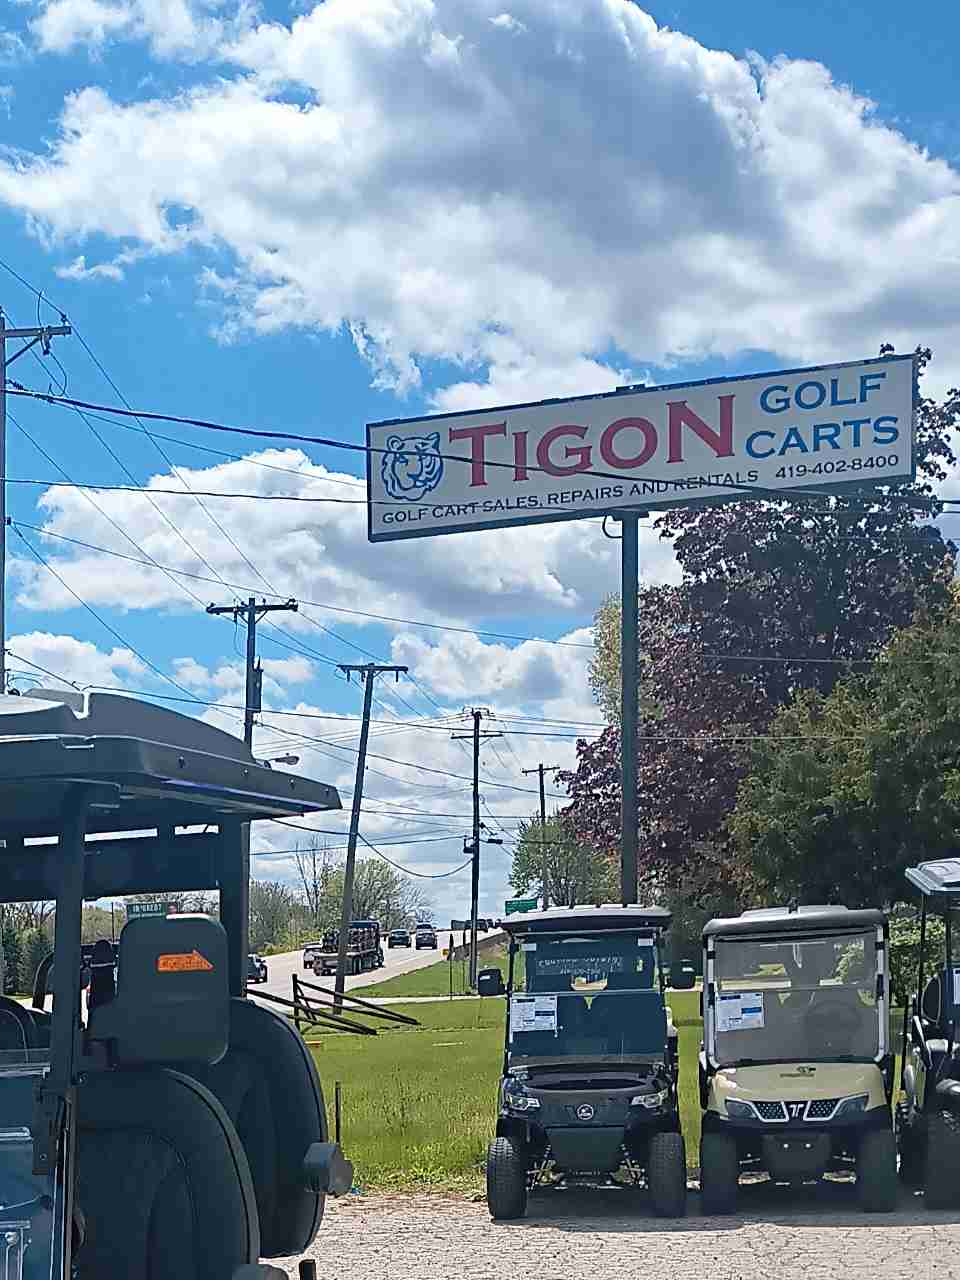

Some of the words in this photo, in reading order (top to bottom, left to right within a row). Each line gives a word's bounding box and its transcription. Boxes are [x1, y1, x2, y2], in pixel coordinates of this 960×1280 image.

[759, 371, 887, 415] GOLF
[448, 393, 737, 488] TIGON
[745, 415, 900, 460] CARTS
[775, 453, 899, 480] 419-402-8400
[382, 507, 429, 524] GOLF
[431, 501, 483, 518] CART
[547, 484, 623, 505] REPAIRS
[629, 478, 668, 497] AND
[673, 470, 758, 490] RENTALS
